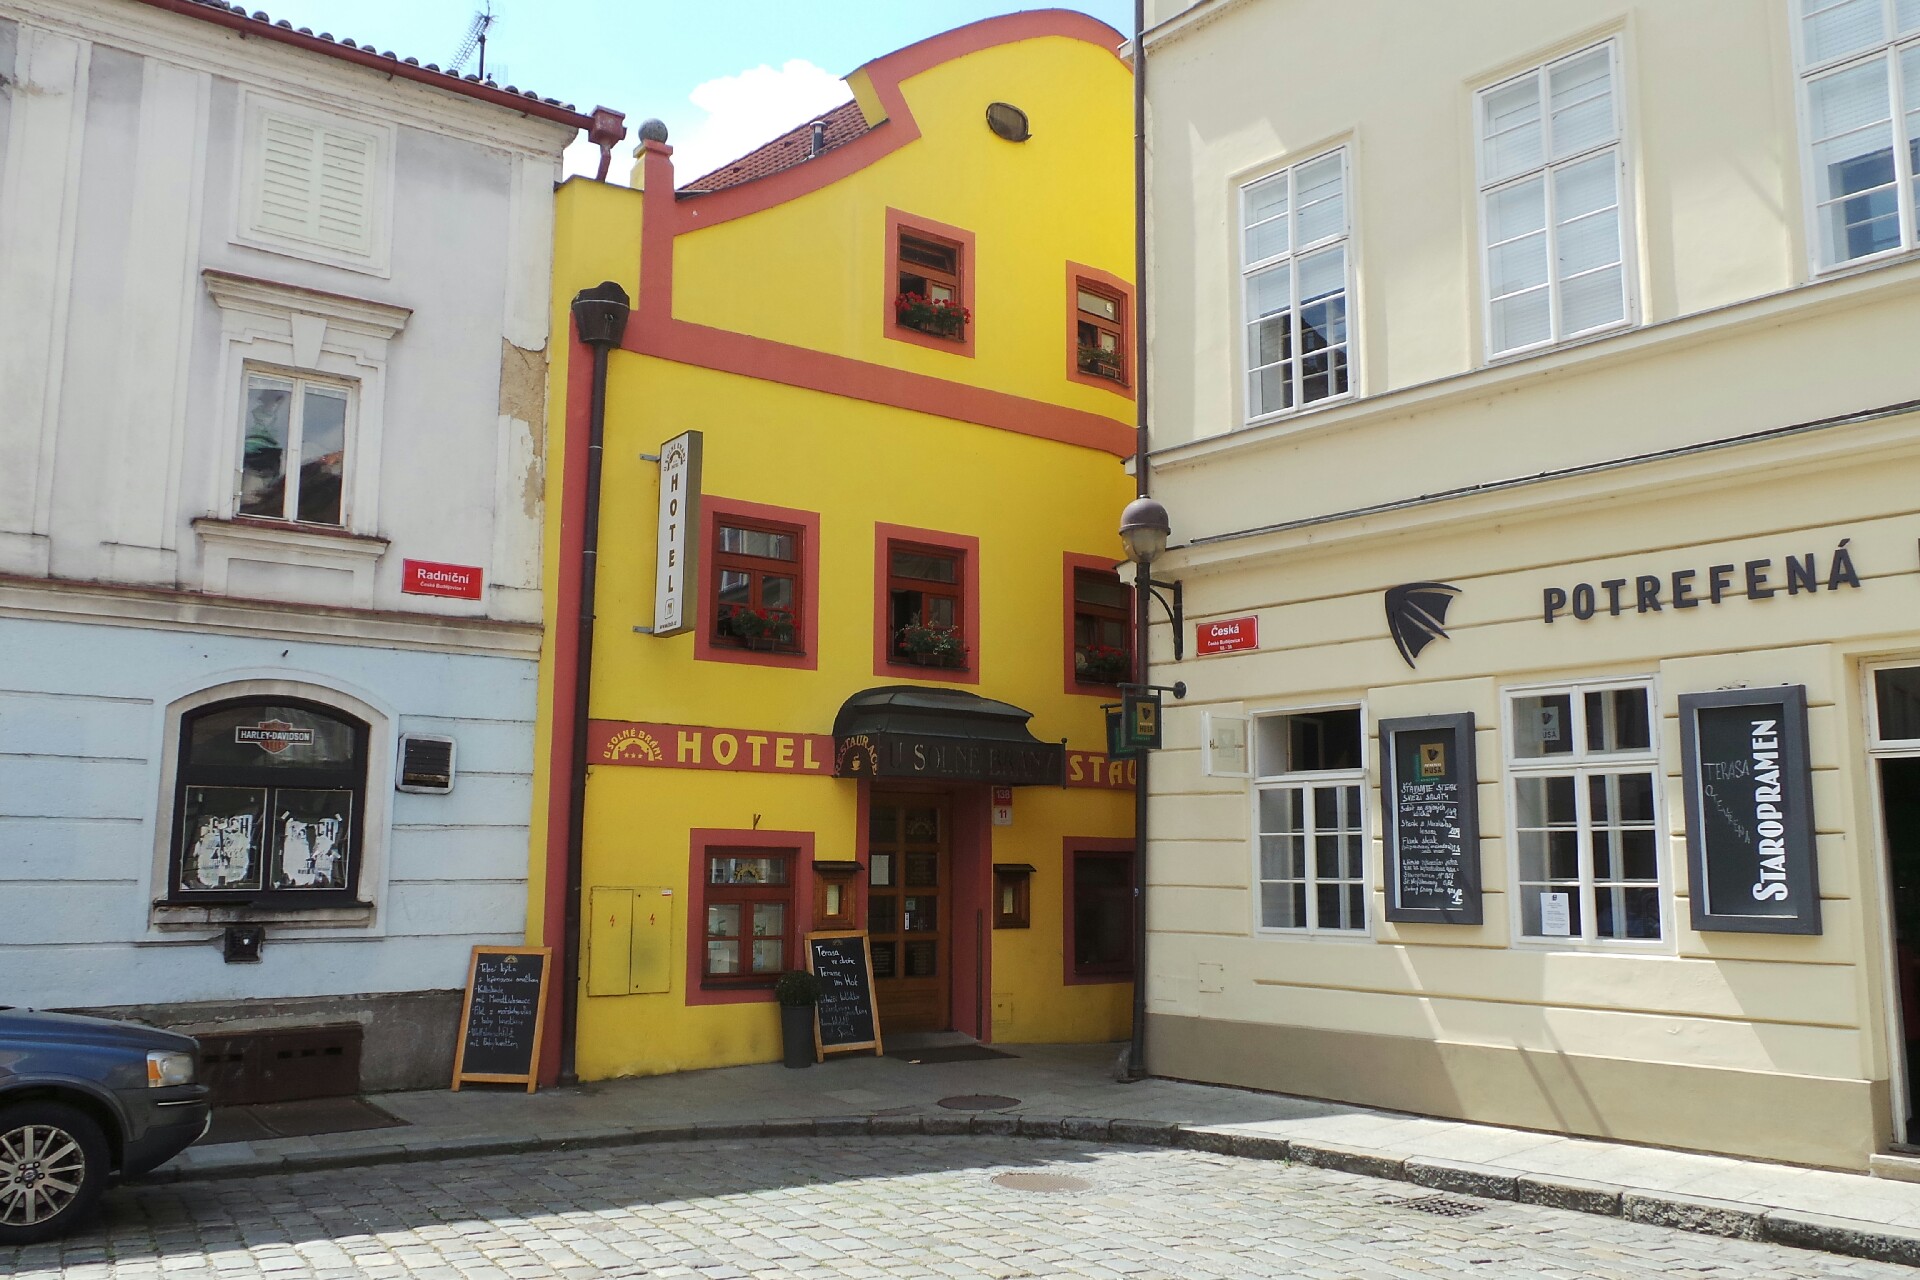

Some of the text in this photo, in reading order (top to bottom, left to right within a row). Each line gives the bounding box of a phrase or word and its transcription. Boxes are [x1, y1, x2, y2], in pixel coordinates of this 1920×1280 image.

[668, 473, 679, 592] HOTEL
[417, 568, 470, 584] Radniční
[1543, 538, 1861, 623] POTREFENÁ
[1211, 623, 1240, 637] Česká
[240, 730, 310, 741] HARLEY-DAVIDSON
[1139, 725, 1154, 733] HUSA
[603, 727, 663, 761] U SOLNÉ BRÁNY
[677, 731, 820, 769] HOTEL
[834, 735, 878, 777] RESTAURACE
[1424, 766, 1442, 774] HUSA
[1703, 760, 1751, 781] TERASA
[996, 789, 1010, 799] 138
[999, 809, 1007, 819] 11
[1751, 719, 1789, 901] STAROPRAMEN
[816, 945, 840, 957] Terasa
